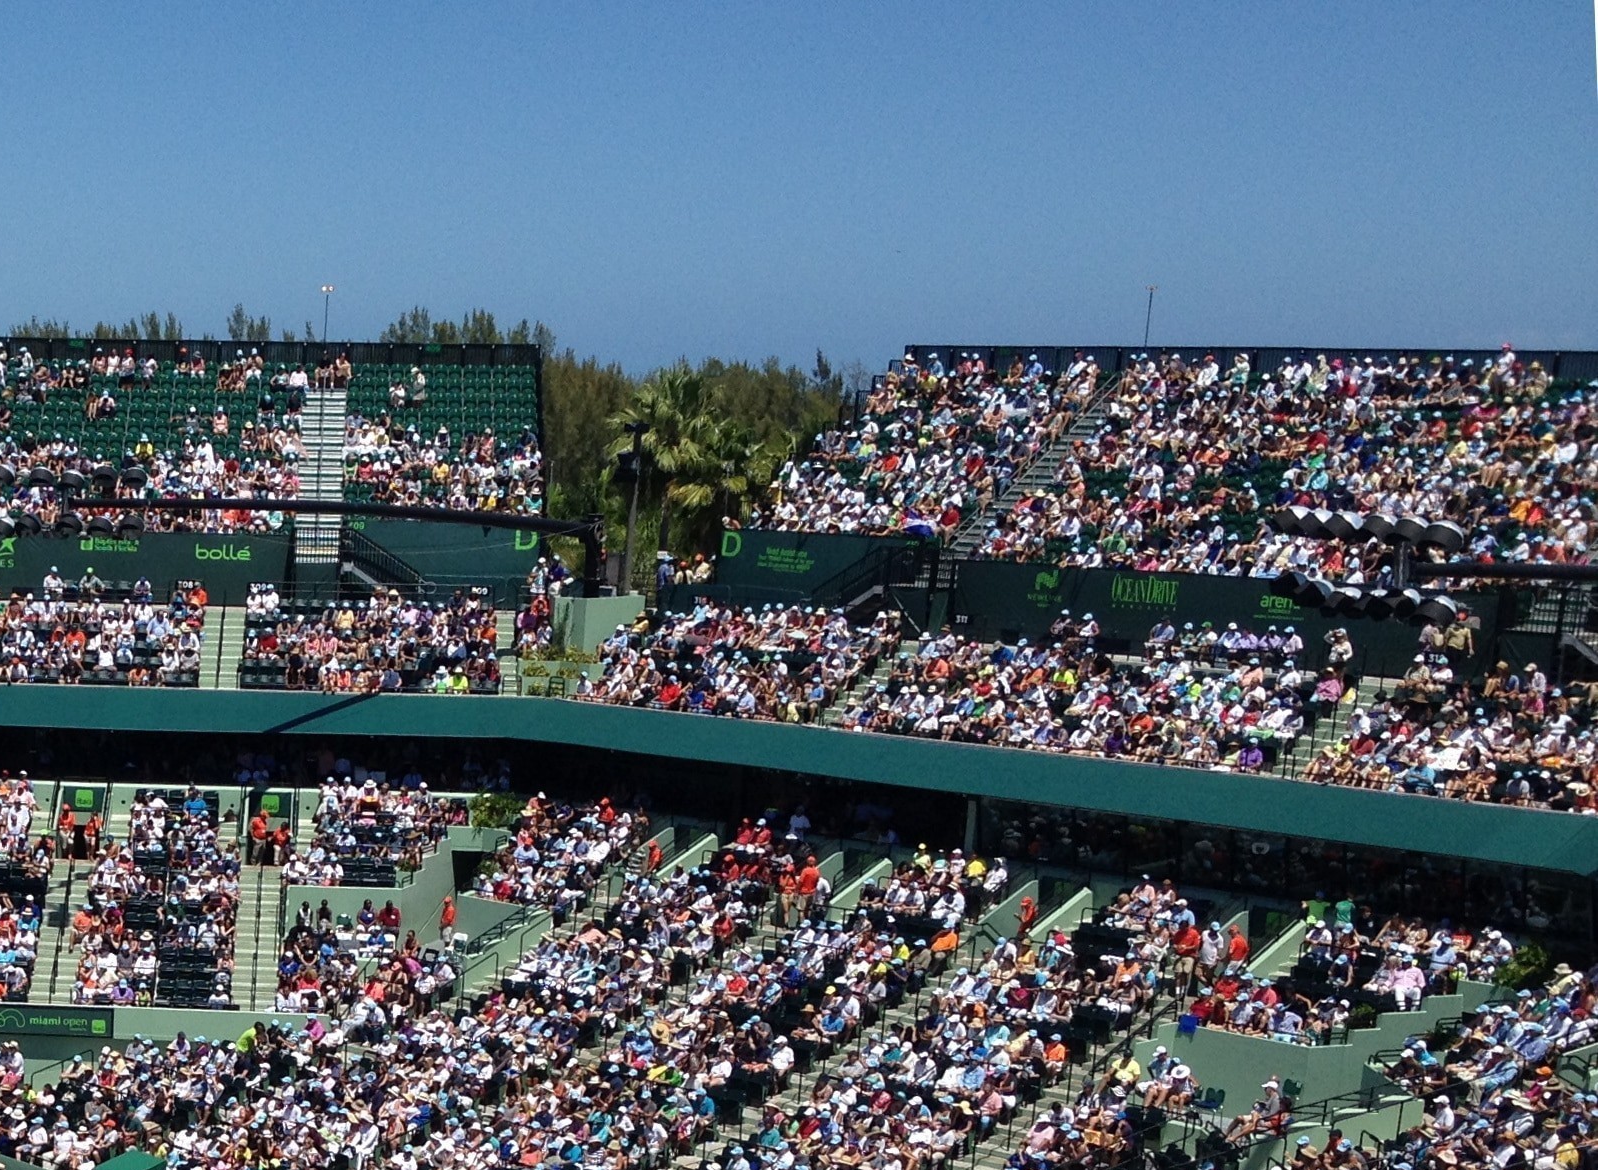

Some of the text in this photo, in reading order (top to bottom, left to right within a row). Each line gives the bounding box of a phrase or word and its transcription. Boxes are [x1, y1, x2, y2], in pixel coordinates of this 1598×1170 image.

[722, 531, 742, 557] D
[195, 544, 251, 561] bollé
[1259, 595, 1300, 609] aren
[29, 1016, 62, 1026] miami
[62, 1018, 88, 1029] open
